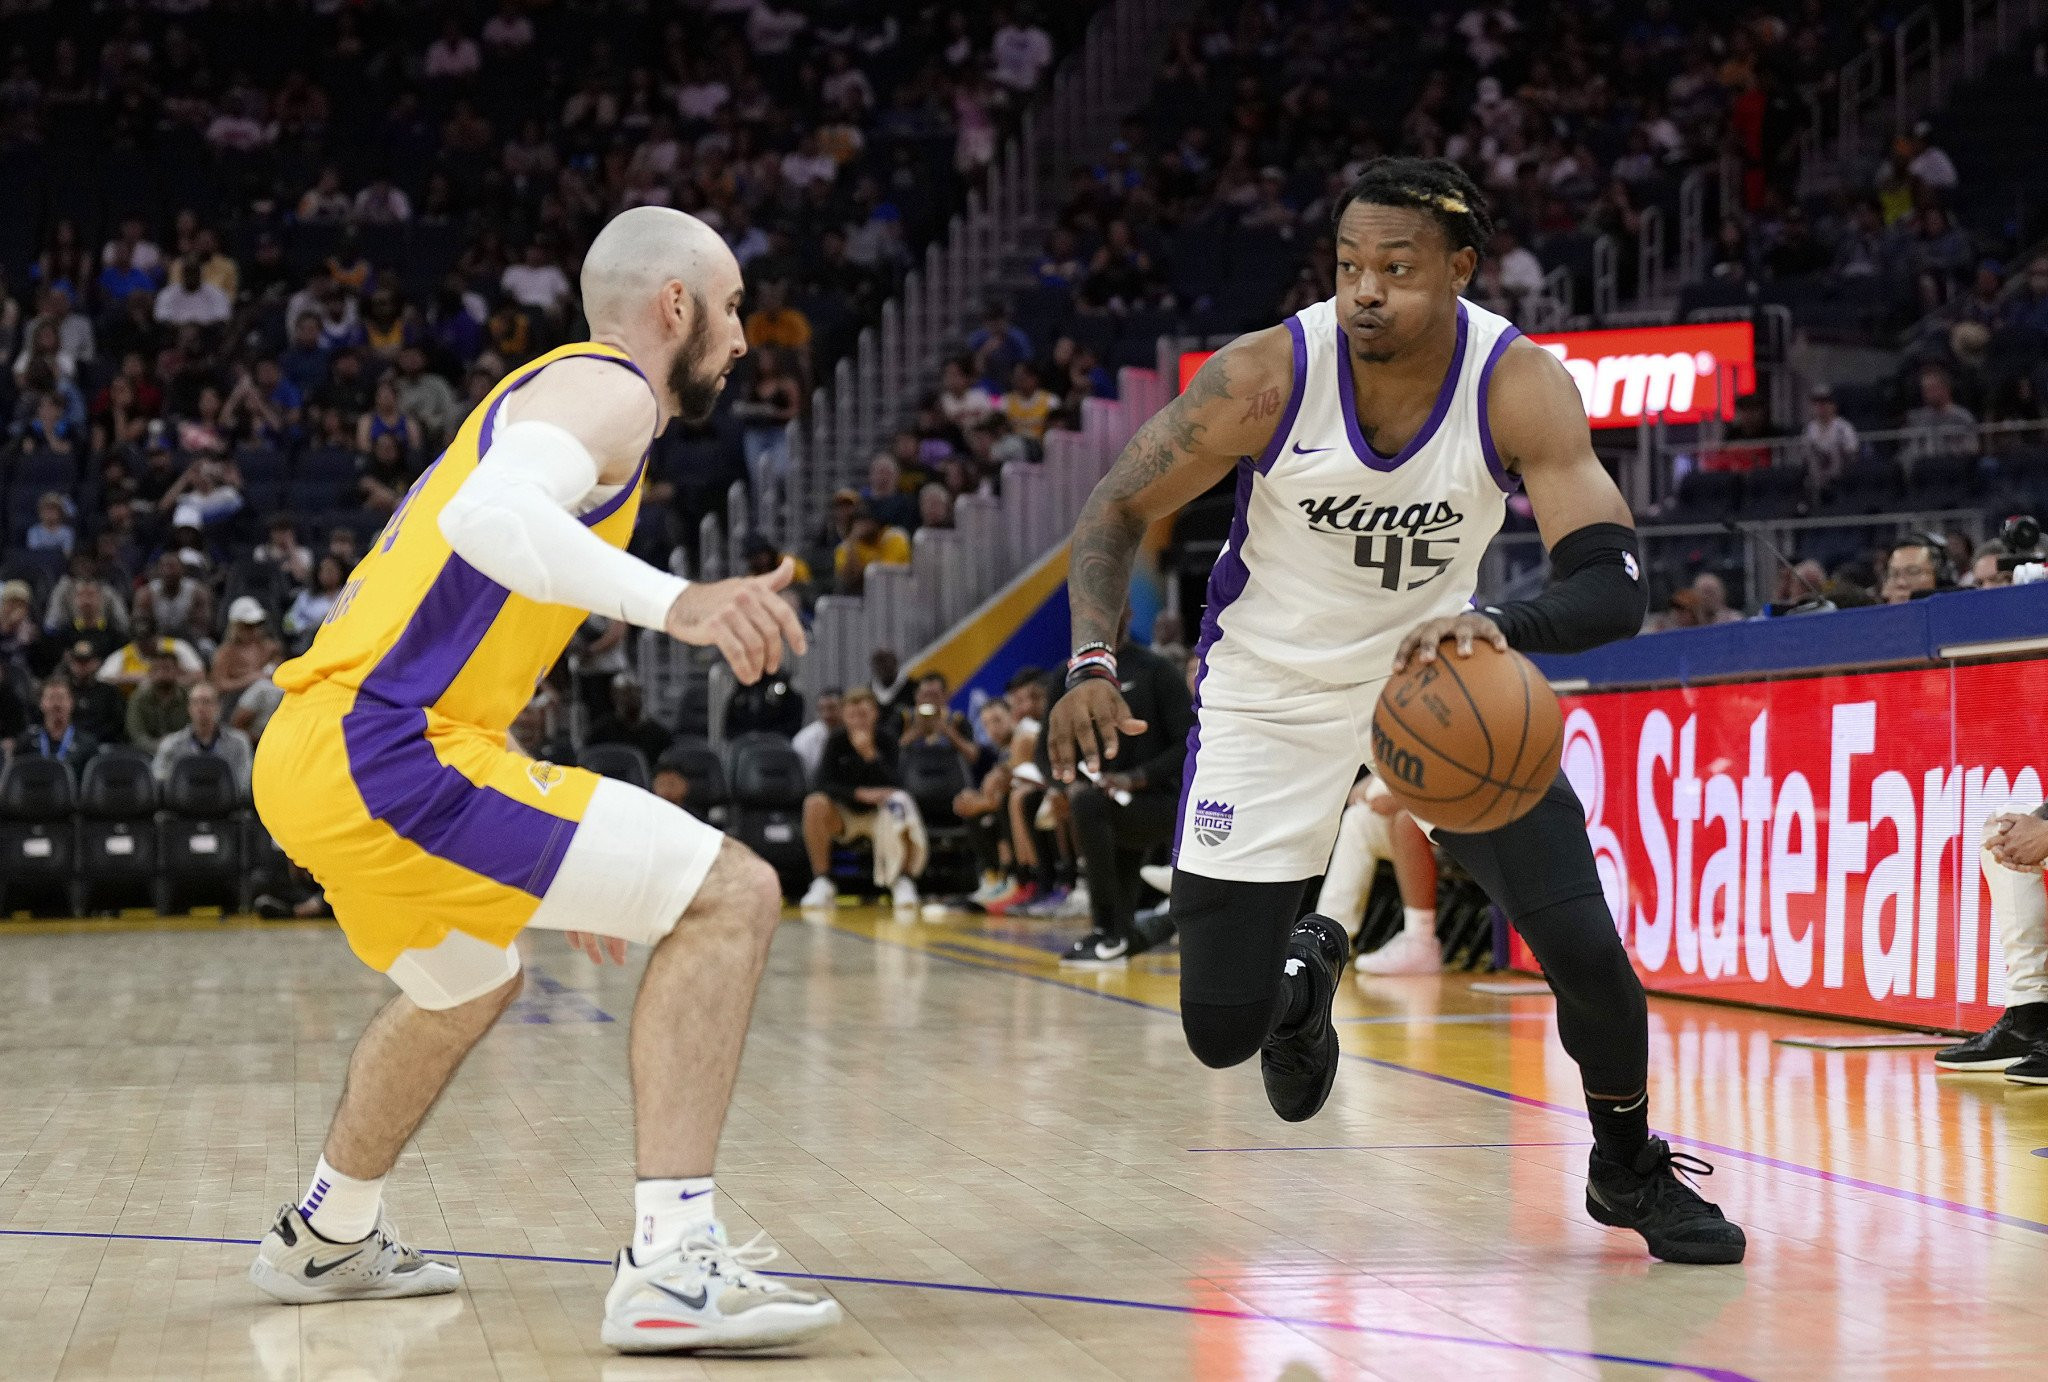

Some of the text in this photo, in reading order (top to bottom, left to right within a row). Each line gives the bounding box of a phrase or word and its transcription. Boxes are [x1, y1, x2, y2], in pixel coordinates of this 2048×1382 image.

[1299, 494, 1464, 537] Kings
[1354, 534, 1460, 591] 45
[1194, 816, 1233, 831] KINGS
